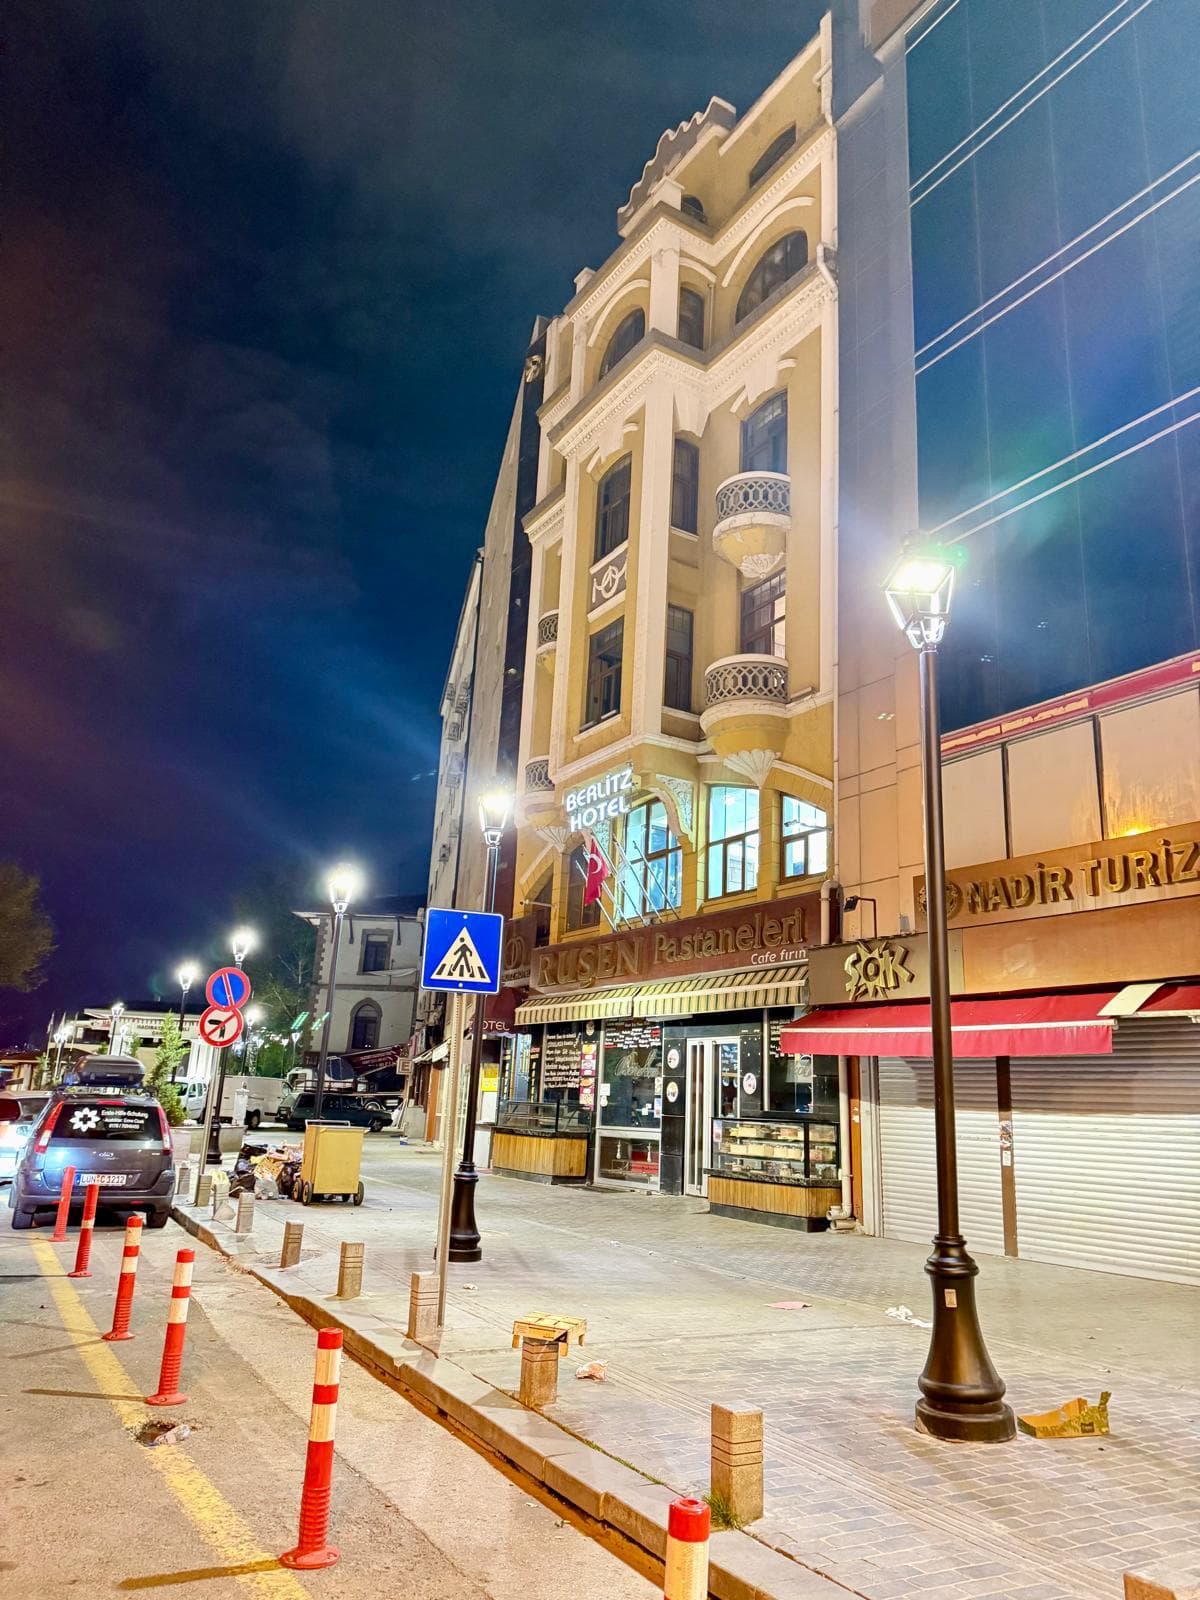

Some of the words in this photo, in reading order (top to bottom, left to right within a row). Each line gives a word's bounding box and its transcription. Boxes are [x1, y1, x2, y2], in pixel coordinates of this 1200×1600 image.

[566, 768, 632, 812] BERLİTZ
[570, 796, 628, 832] HOTEL
[967, 862, 1074, 914] NADİR
[653, 907, 806, 965] Pastaneleri
[751, 951, 777, 965] Cafe
